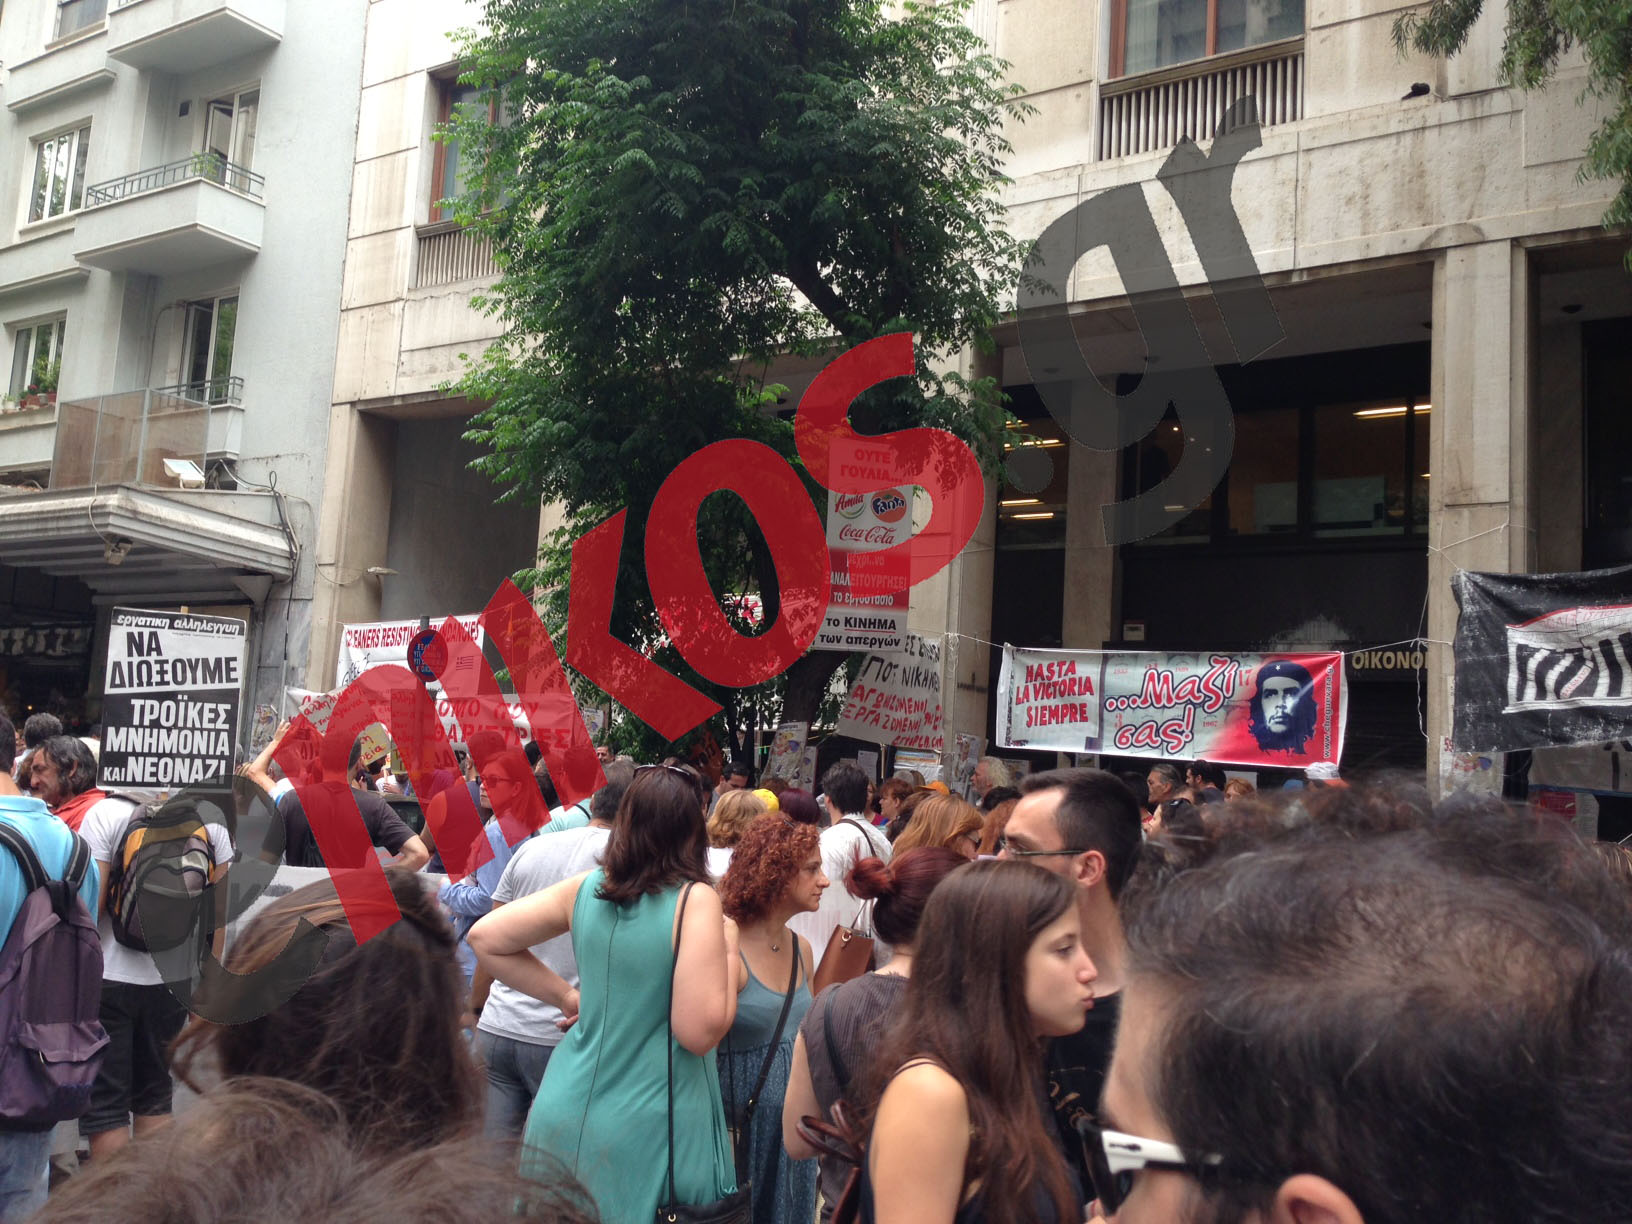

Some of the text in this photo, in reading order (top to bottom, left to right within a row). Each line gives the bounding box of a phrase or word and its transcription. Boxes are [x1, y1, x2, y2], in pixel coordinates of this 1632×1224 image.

[855, 449, 892, 464] ΟΥΤΕ
[872, 496, 905, 515] Fanta
[839, 523, 897, 545] Coca-Cola
[833, 591, 843, 603] το
[117, 614, 240, 635] εργατικη αλληλεγγυη
[826, 616, 897, 631] το ΚΙΝΗΜΑ
[126, 630, 163, 658] ΝΑ
[346, 627, 381, 649] CLEANERS
[381, 624, 420, 648] RESISTIN
[820, 634, 842, 644] των
[845, 635, 901, 649] απεργών
[109, 656, 238, 689] ΔΙΩΞΟΥΜΕ
[1025, 660, 1077, 683] HASTA
[1352, 651, 1428, 670] ΟΙΚΟΝΟ
[1015, 676, 1095, 705] LA VICTORIA
[130, 694, 231, 730] ΤΡΟΪΚΕΣ
[1026, 702, 1088, 728] SIEMPRE
[105, 726, 230, 756] ΜΝΗΜΟΝΙΑ
[1114, 704, 1196, 754] σας!
[103, 756, 226, 784] ΚΑΙ ΝΕΟΝΑΖΙ
